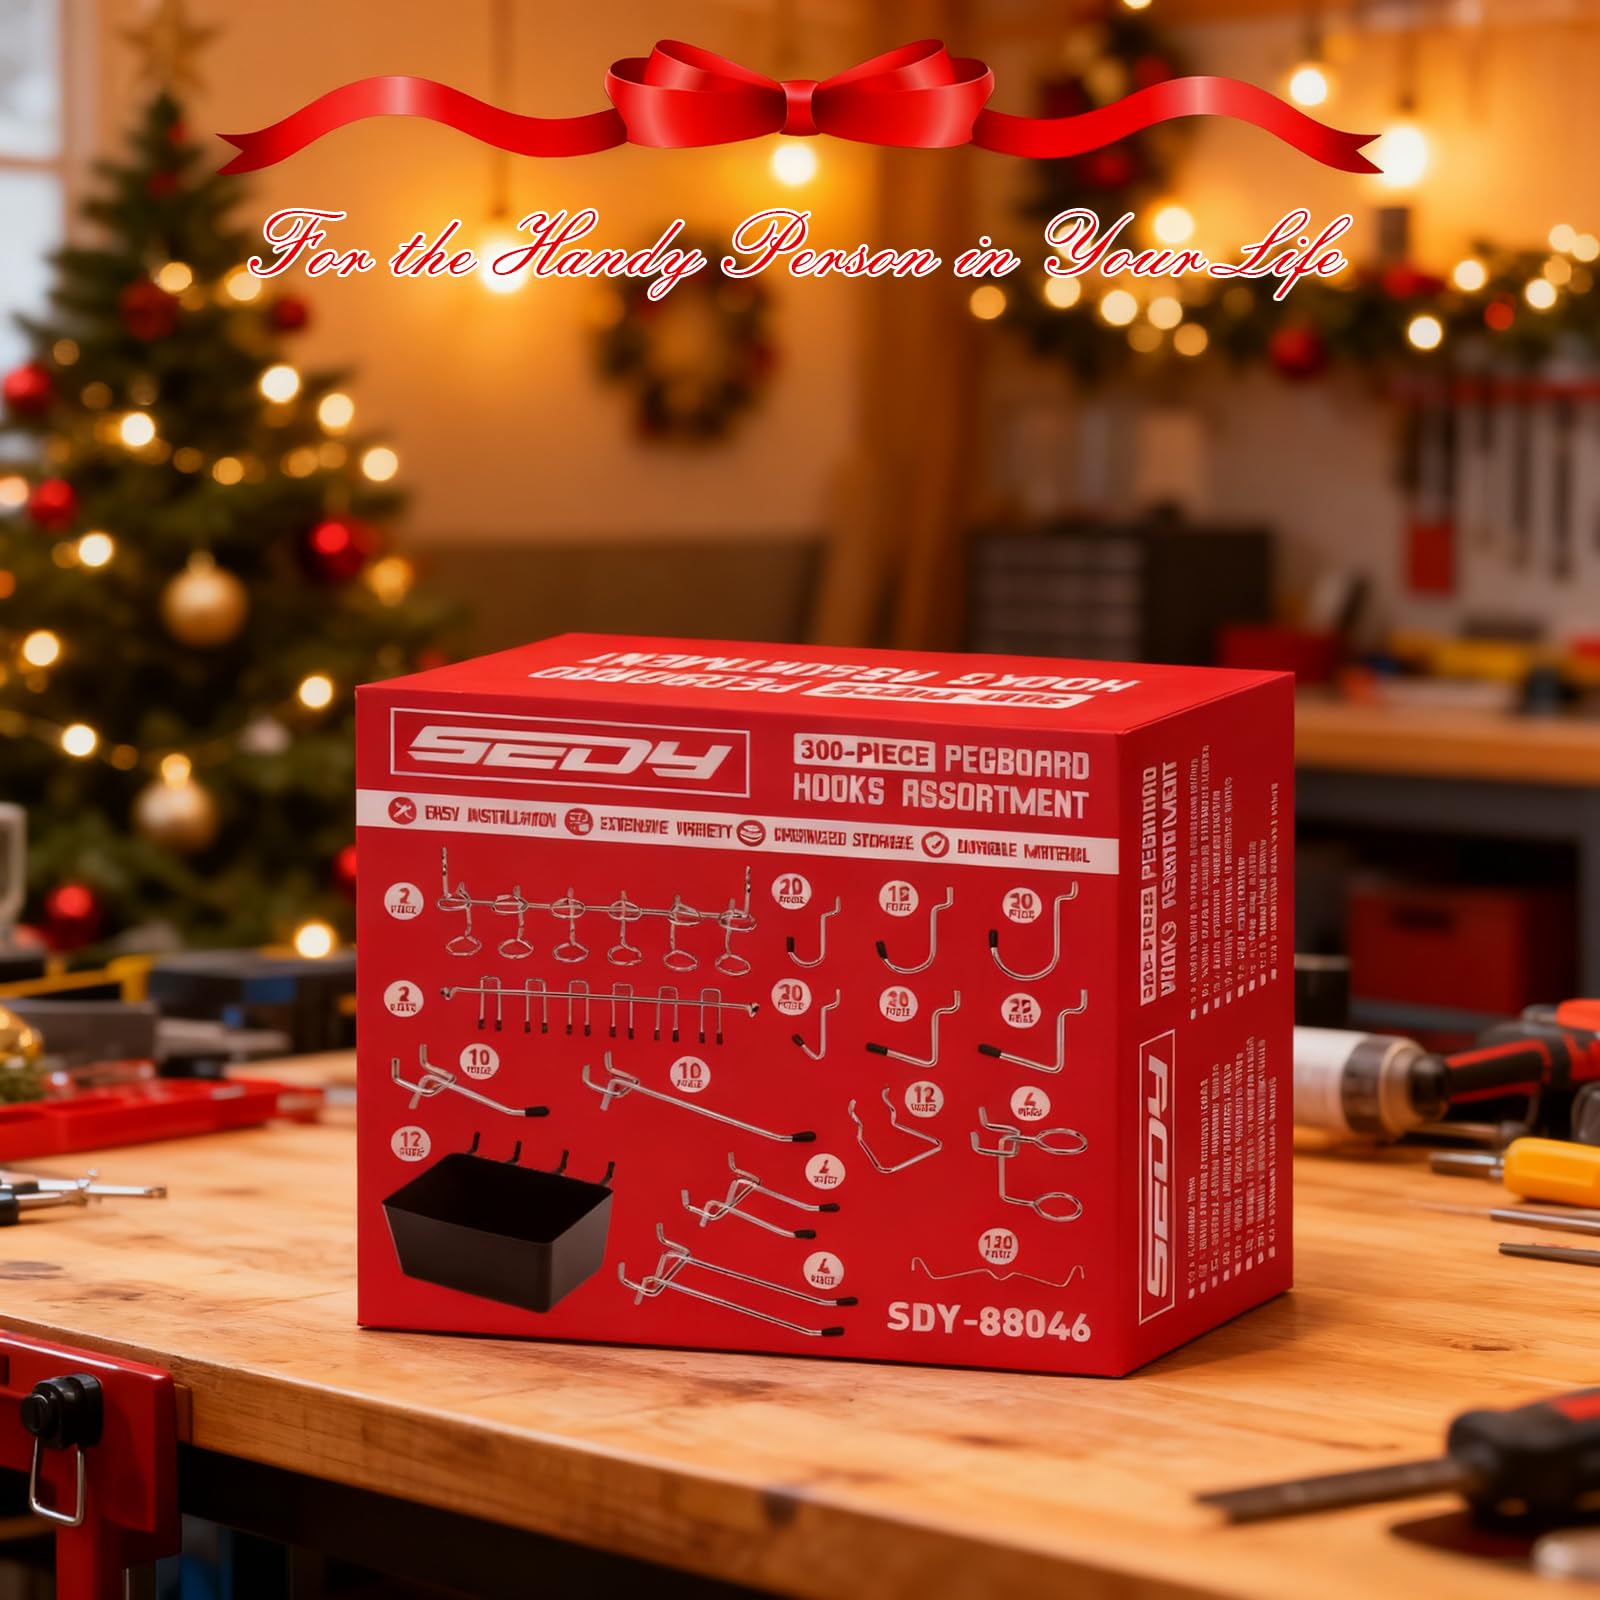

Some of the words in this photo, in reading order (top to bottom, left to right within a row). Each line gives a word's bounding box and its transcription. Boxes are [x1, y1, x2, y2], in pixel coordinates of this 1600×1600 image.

[407, 725, 733, 780] SEDY
[801, 739, 929, 766] 300-PIECE
[945, 745, 1089, 780] PEGBOARD
[793, 773, 884, 805] HOOKS
[902, 778, 1089, 819] ASSORTMENT
[780, 878, 803, 895] 20
[400, 888, 411, 904] 2
[1010, 893, 1032, 909] 20
[398, 986, 410, 1001] 2
[779, 984, 803, 1001] 20
[469, 1049, 491, 1066] 10
[679, 1062, 701, 1079] 10
[914, 1087, 936, 1104] 12
[401, 1132, 422, 1147] 12
[1147, 1055, 1168, 1298] SEDY
[887, 1301, 1091, 1343] SDY-88046
